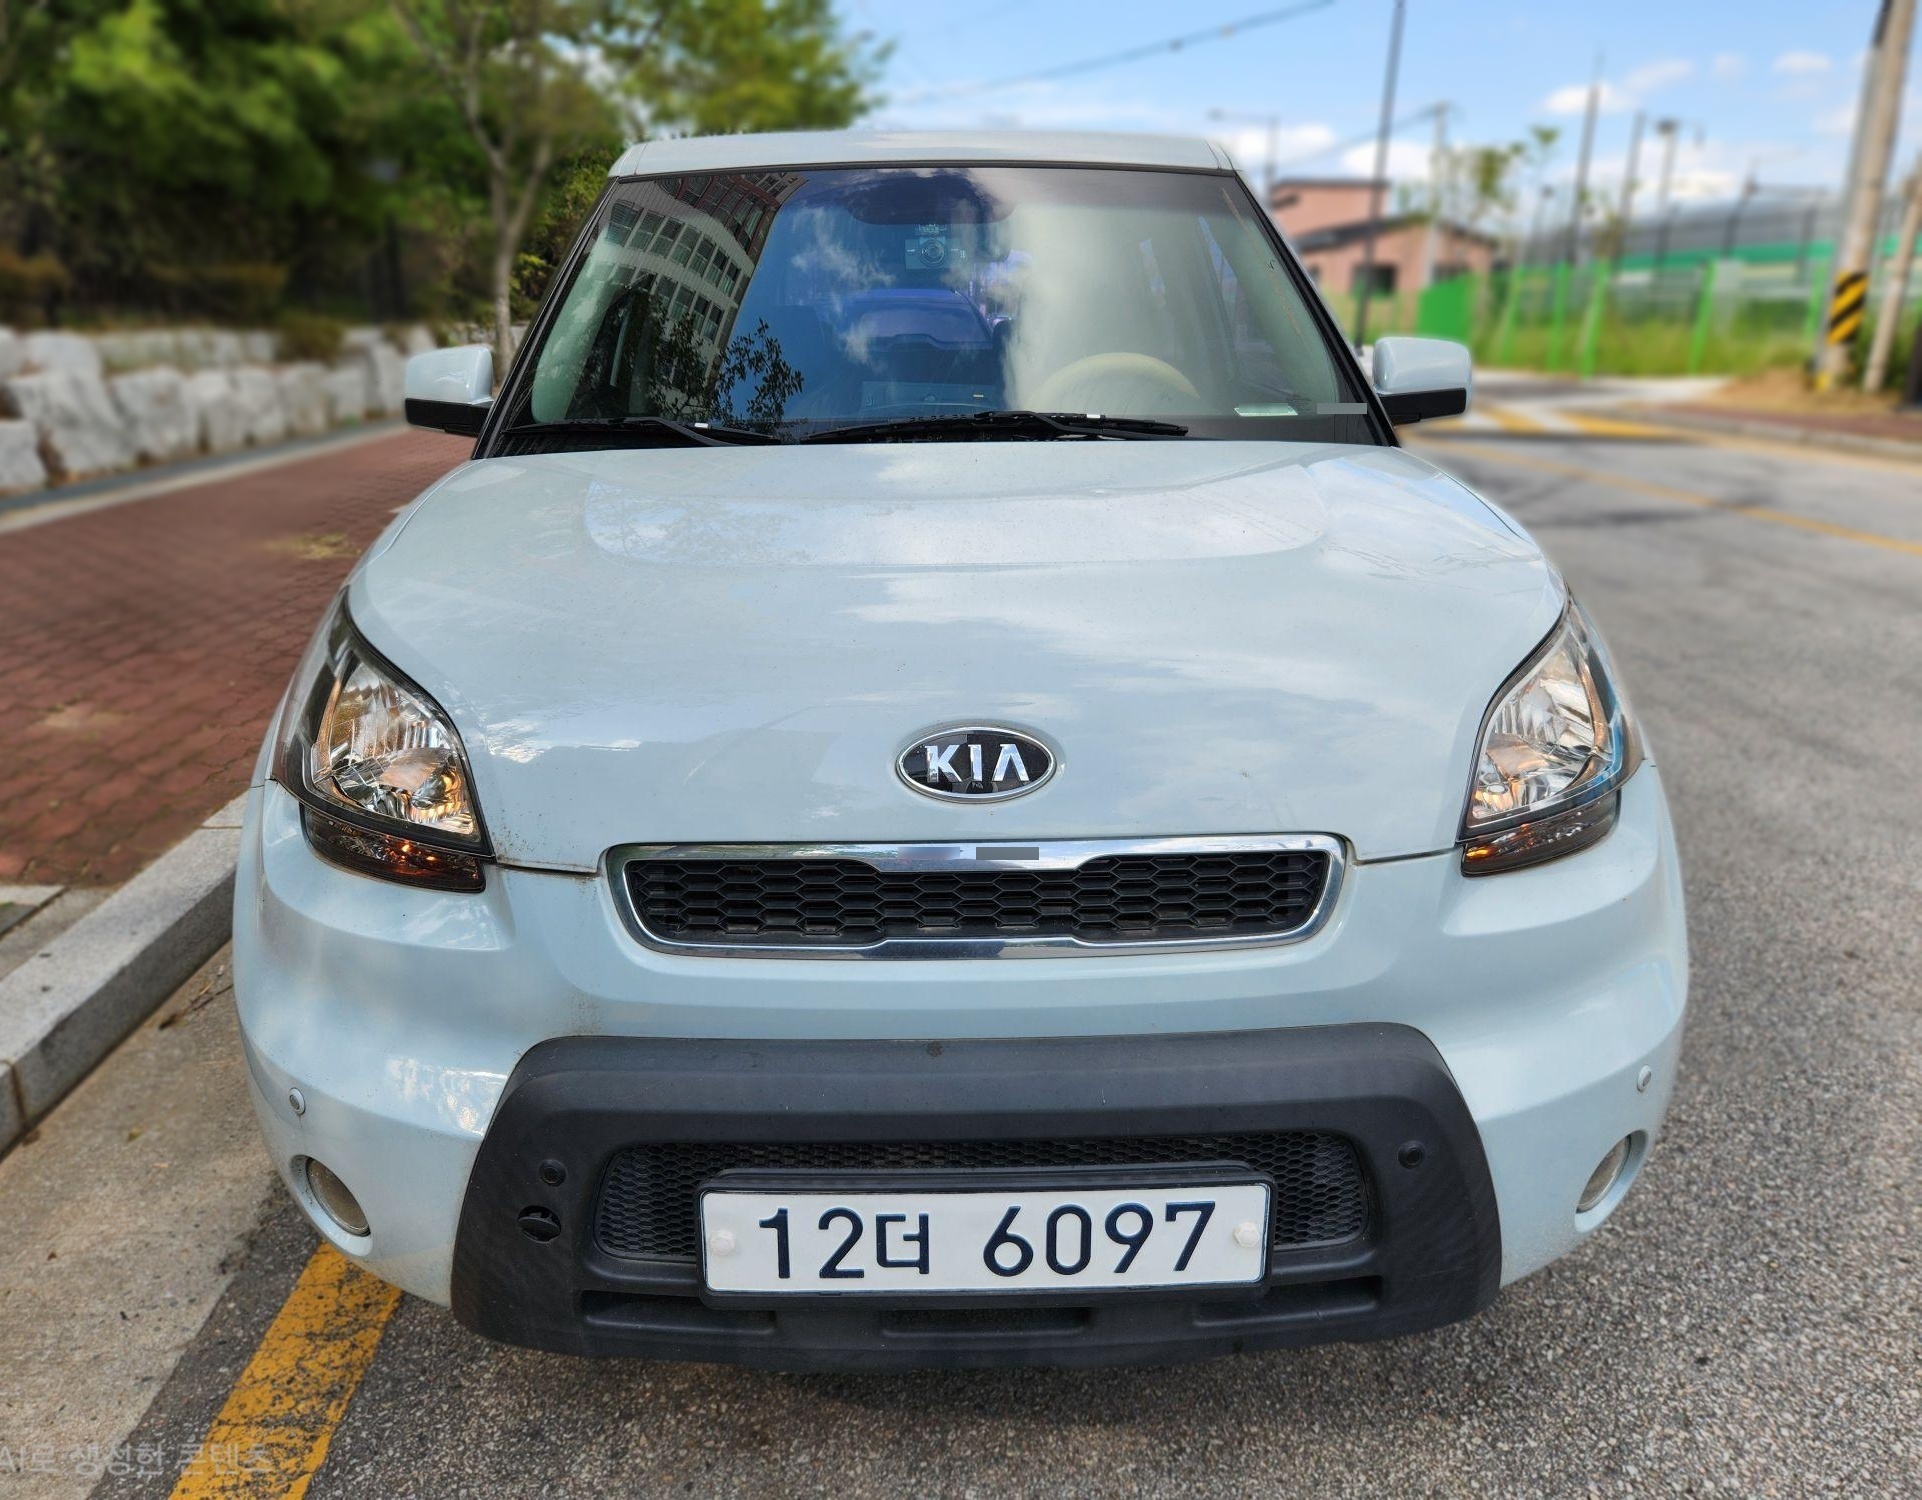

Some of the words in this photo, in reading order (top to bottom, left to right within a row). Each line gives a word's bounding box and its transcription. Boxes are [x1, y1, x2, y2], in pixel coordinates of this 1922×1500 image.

[924, 743, 1030, 783] KIA
[758, 1206, 930, 1279] 12더
[983, 1200, 1216, 1278] 6097
